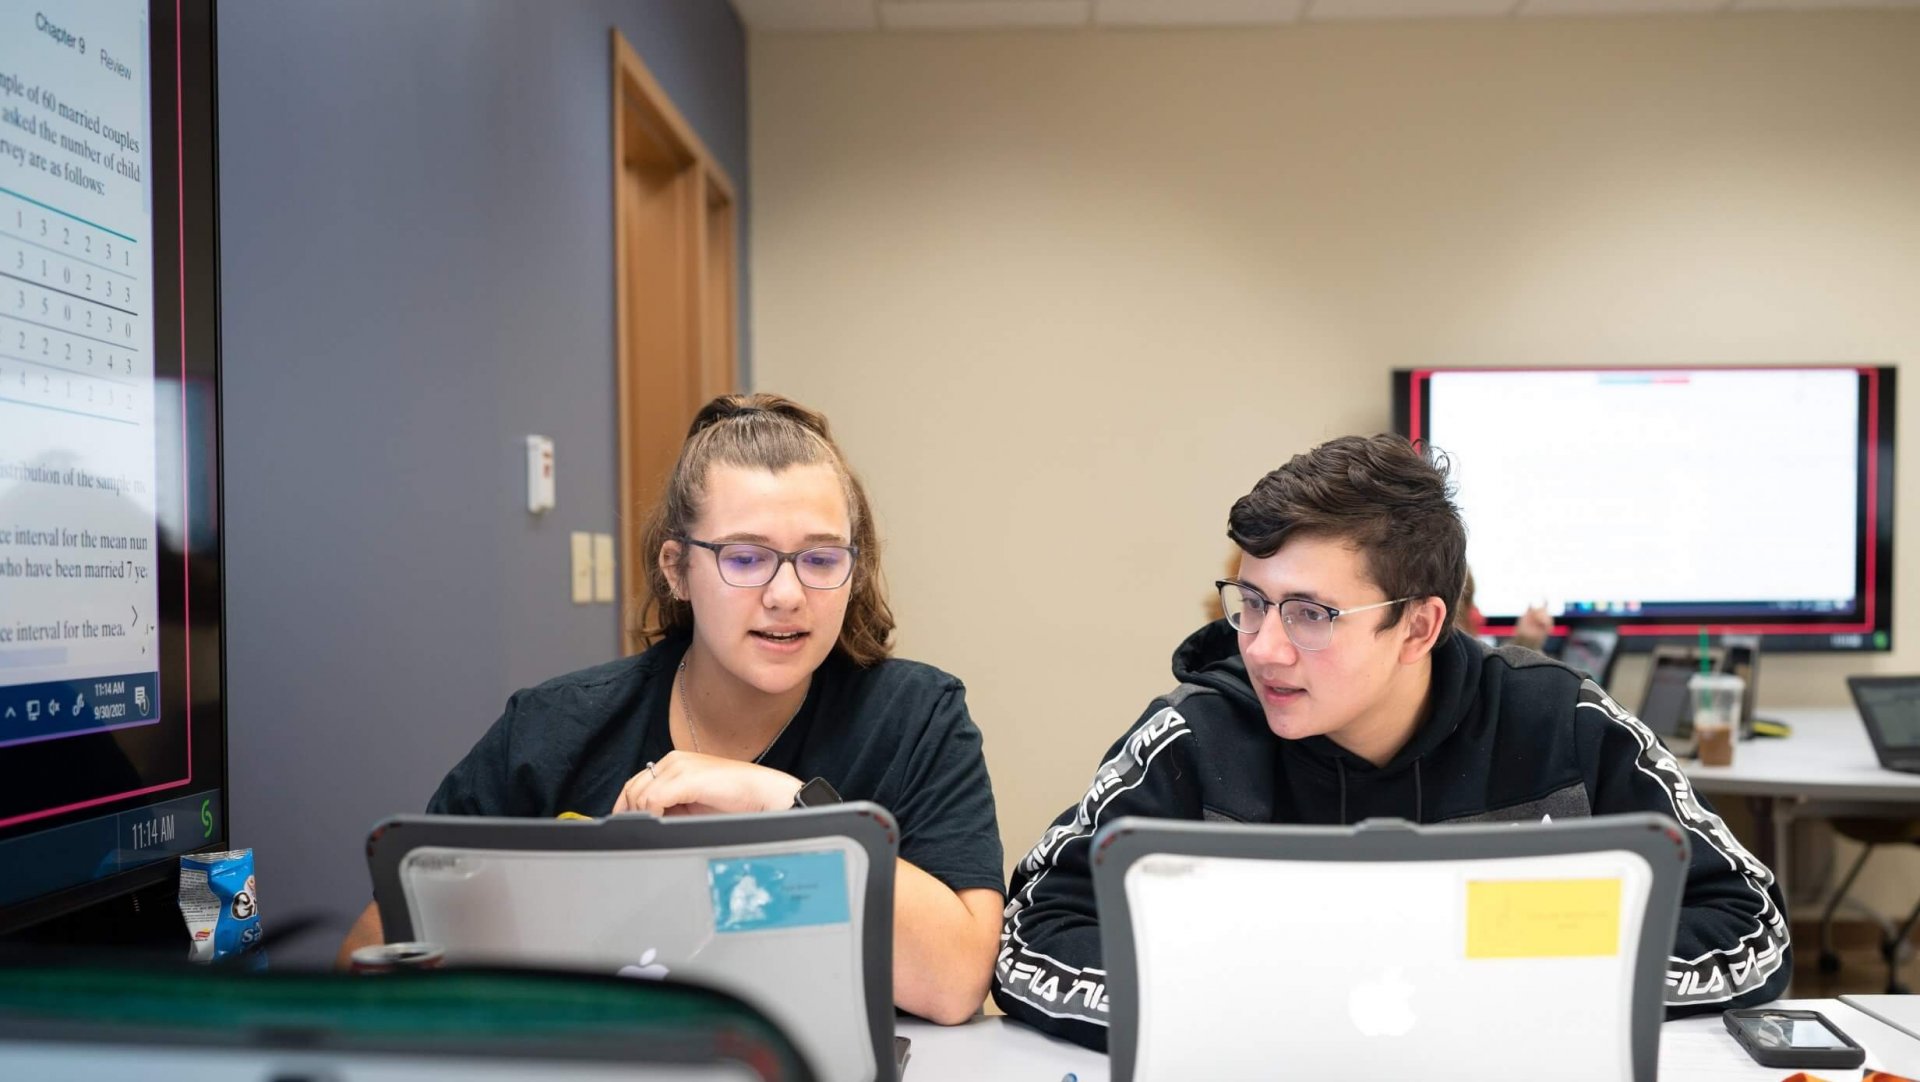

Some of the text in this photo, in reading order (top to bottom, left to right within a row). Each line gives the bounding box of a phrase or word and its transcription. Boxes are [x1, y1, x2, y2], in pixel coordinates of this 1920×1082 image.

[35, 12, 86, 55] Chapter 9
[100, 48, 132, 80] Review
[27, 85, 39, 104] of
[42, 90, 56, 112] 60
[58, 101, 100, 135] married
[103, 124, 140, 153] couples
[2, 107, 141, 183] asked the number of child
[29, 151, 47, 172] are
[50, 162, 62, 178] as
[65, 161, 105, 196] follows:
[41, 218, 48, 237] 3
[63, 227, 70, 246] 2
[85, 235, 91, 254] 2
[106, 243, 112, 260] 3
[17, 251, 24, 270] 3
[63, 266, 71, 284] 0
[86, 274, 92, 292] 2
[106, 280, 112, 298] 3
[125, 287, 131, 304] 3
[64, 304, 71, 322] 0
[86, 310, 93, 328] 2
[107, 316, 113, 333] 3
[125, 322, 132, 338] 0
[19, 331, 132, 375] 2 2 2 3 4 3
[63, 467, 75, 486] of
[76, 470, 94, 489] the
[95, 477, 130, 496] sample
[15, 525, 59, 547] interval
[62, 529, 78, 547] for
[81, 530, 97, 549] the
[100, 535, 128, 551] mean
[25, 558, 52, 579] have
[55, 559, 82, 579] been
[84, 559, 125, 579] married
[126, 561, 133, 579] 7
[16, 620, 61, 642] interval
[63, 621, 80, 640] for
[82, 620, 99, 639] the
[95, 680, 125, 697] 11:14 AM
[94, 704, 126, 720] 9/30/2021
[1131, 710, 1186, 767] FILA
[132, 813, 176, 852] 11:14 AM
[1008, 961, 1059, 1002] FILA
[1664, 964, 1725, 997] FILA
